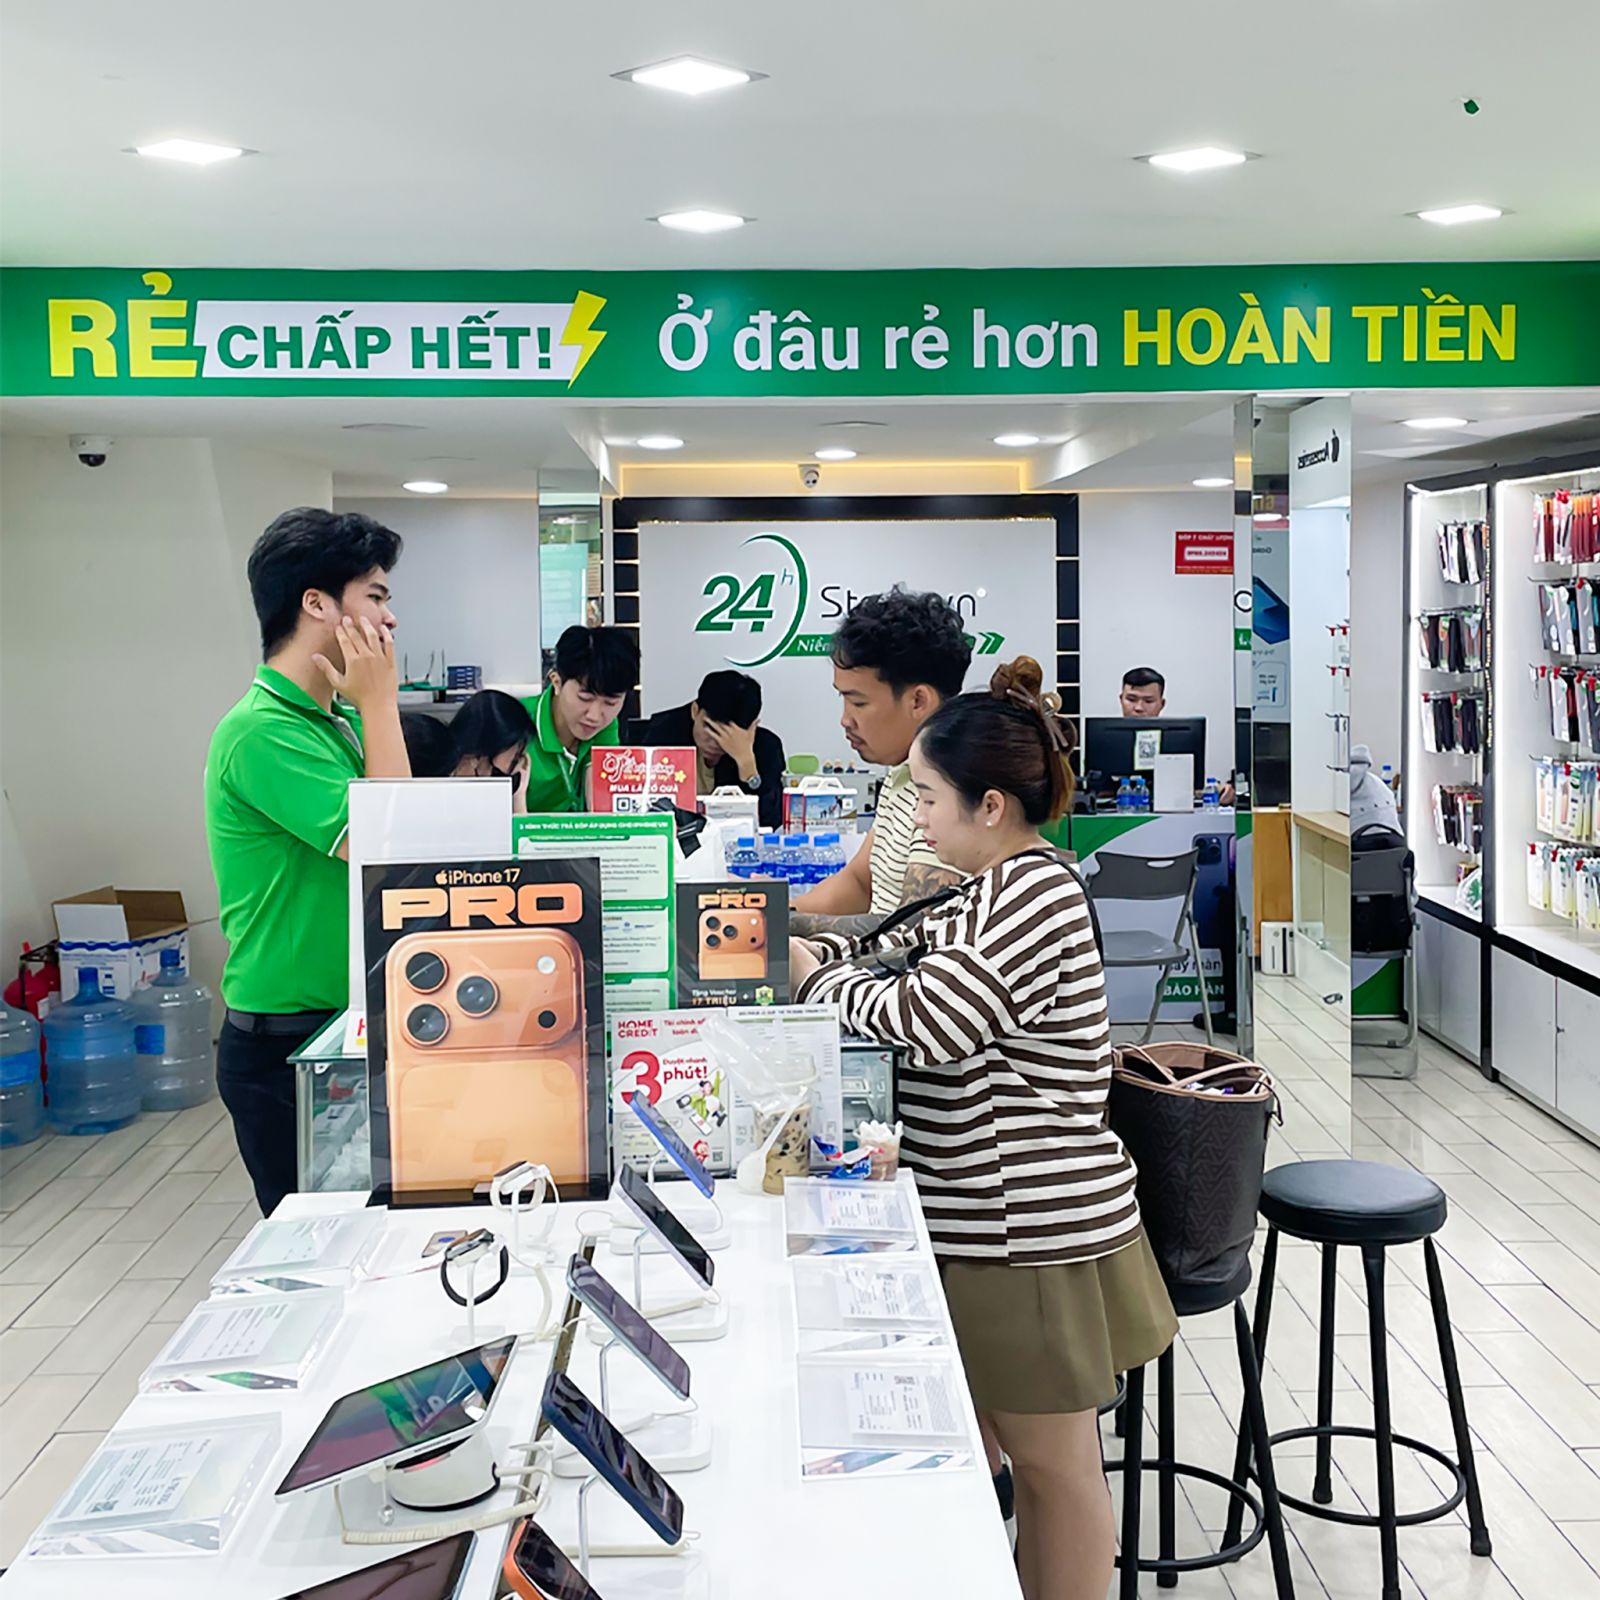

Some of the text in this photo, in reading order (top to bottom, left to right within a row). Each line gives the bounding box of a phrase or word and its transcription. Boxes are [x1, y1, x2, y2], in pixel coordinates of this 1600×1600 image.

[48, 271, 552, 379] RẺ CHẤP HẾT!
[659, 287, 1517, 371] Ở đâu rẻ hơn HOÀN TIỀN
[448, 868, 521, 884] iPhone 17
[382, 883, 583, 930] PRO
[698, 893, 767, 909] PRO
[618, 1020, 653, 1029] HOME
[618, 1029, 658, 1038] CREDIT
[621, 1050, 663, 1108] 3
[663, 1066, 708, 1085] phút!
